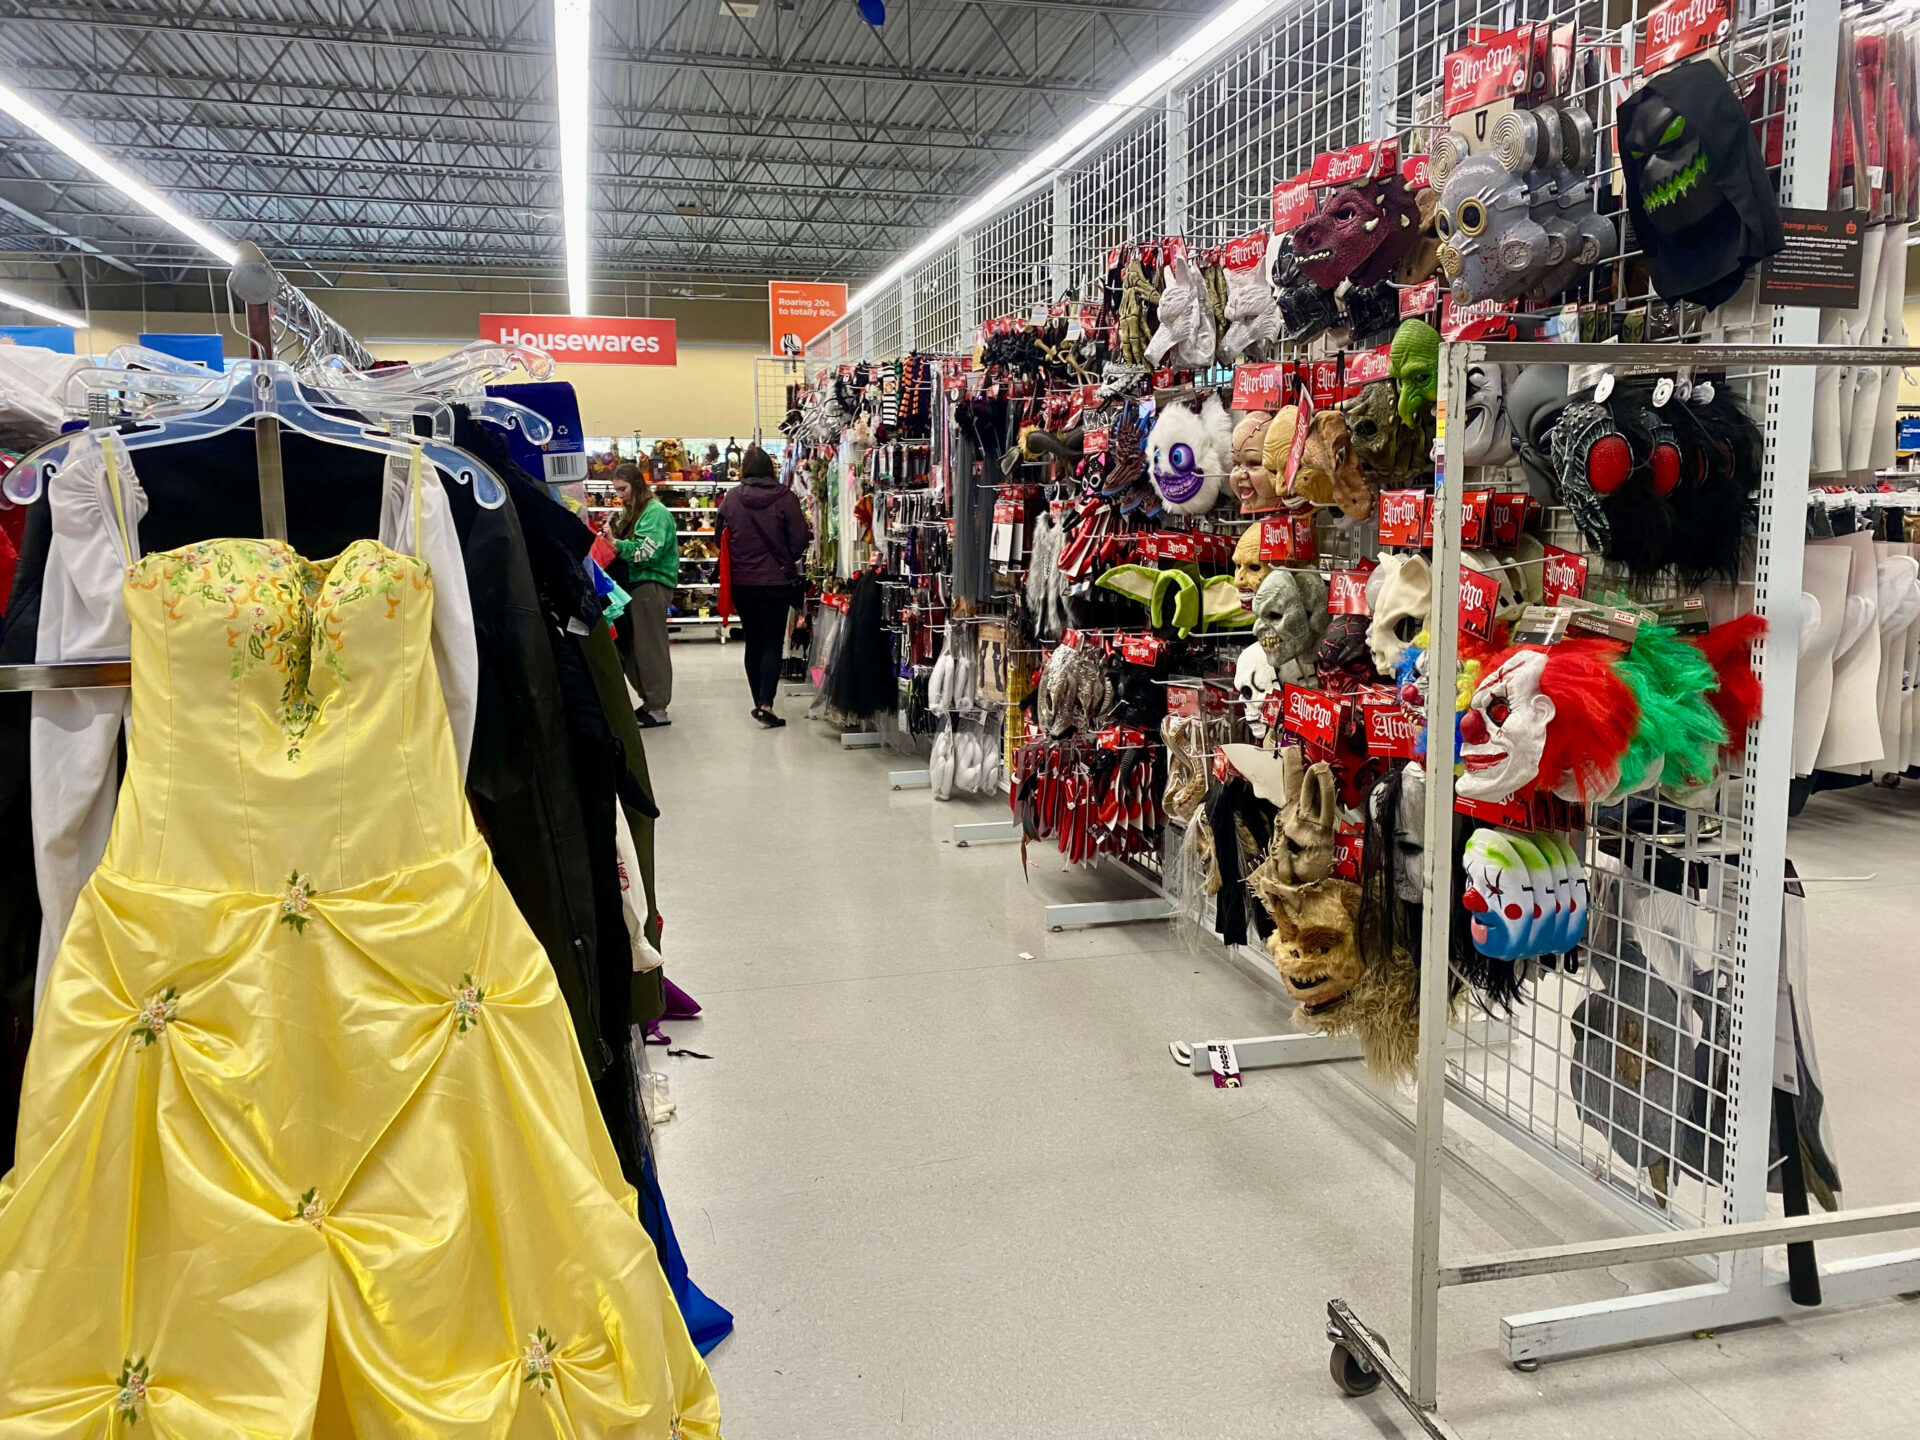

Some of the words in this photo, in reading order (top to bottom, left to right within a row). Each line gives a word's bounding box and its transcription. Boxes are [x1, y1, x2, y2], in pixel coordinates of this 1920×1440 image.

[1807, 222, 1828, 232] policy
[778, 298, 812, 307] Roaring
[814, 299, 830, 307] 20s
[790, 308, 818, 317] totally
[500, 327, 660, 353] Housewares
